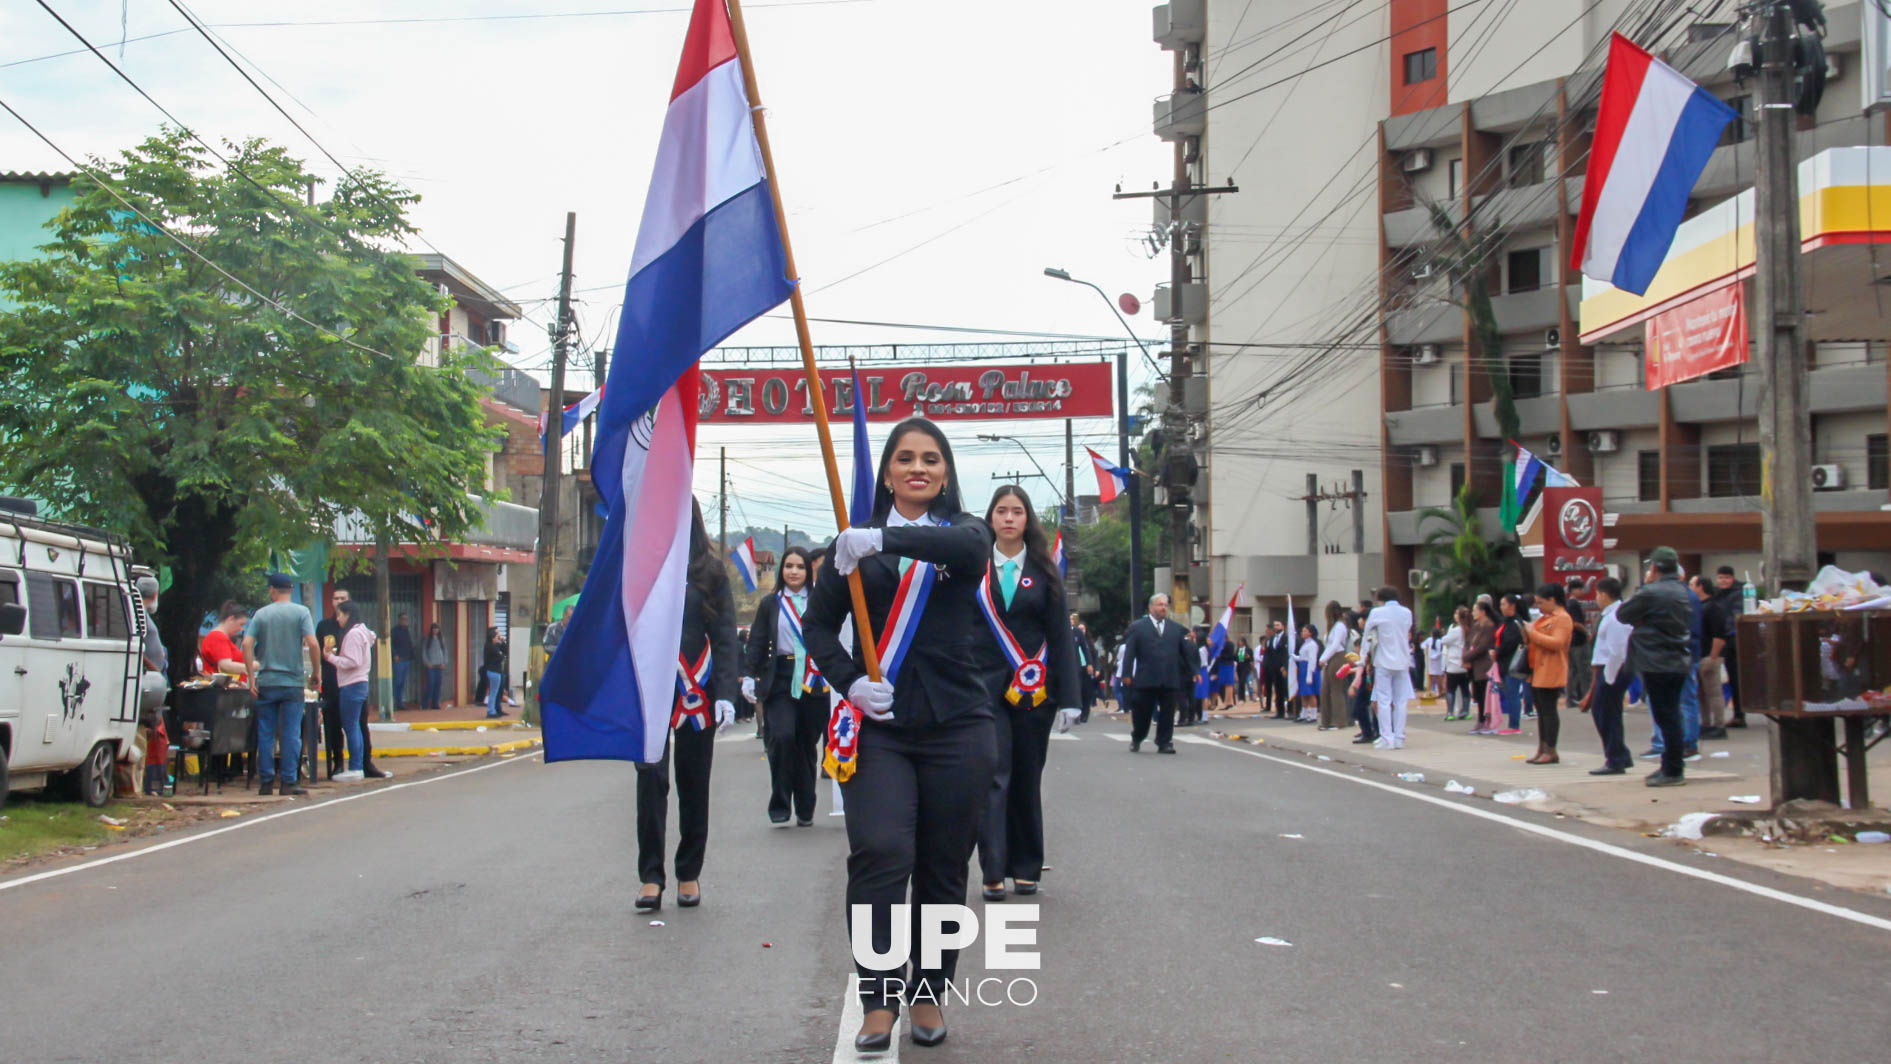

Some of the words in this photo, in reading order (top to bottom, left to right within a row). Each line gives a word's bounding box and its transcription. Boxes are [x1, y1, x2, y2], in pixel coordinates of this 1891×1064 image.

[724, 376, 895, 415] HOTEL
[900, 371, 973, 402] Rosa
[978, 369, 1072, 400] Palace
